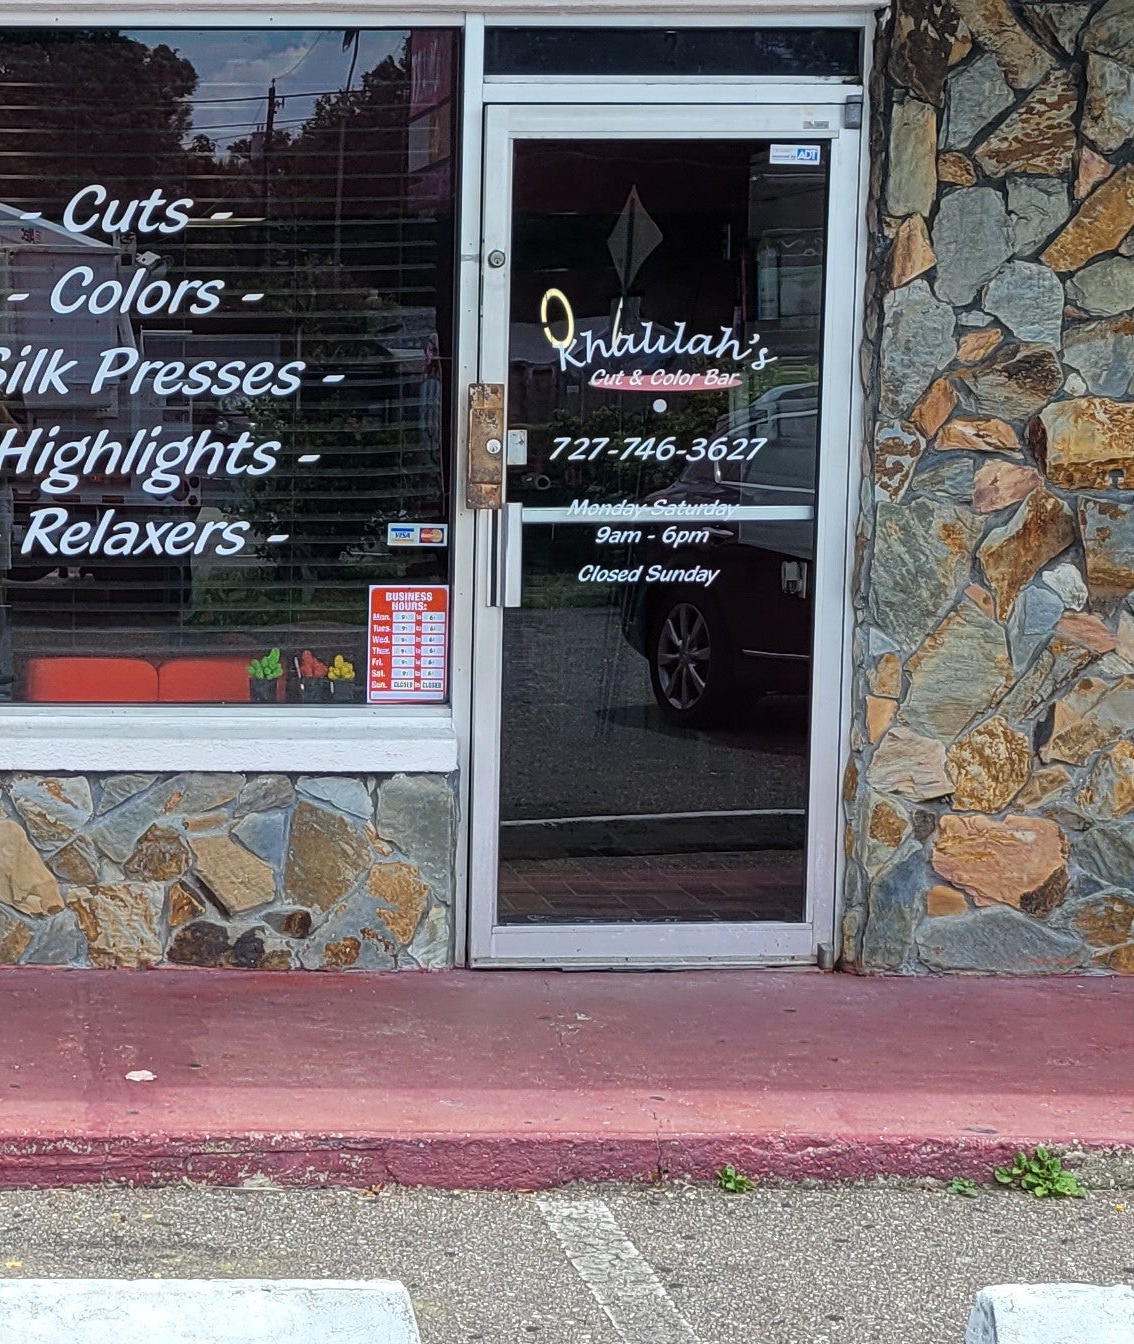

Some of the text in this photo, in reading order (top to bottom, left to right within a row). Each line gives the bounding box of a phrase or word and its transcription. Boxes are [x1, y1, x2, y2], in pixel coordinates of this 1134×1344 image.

[798, 149, 818, 160] ADT
[63, 184, 194, 233] Cuts
[50, 265, 226, 315] Colors
[552, 321, 778, 372] Khalilah's
[90, 346, 306, 395] Presses
[590, 368, 741, 387] Cut & Color Bar
[549, 437, 768, 462] 727-746-3627
[20, 507, 251, 556] Relaxers
[595, 526, 641, 544] 9am
[661, 526, 709, 548] 6pm
[578, 564, 720, 586] Closed Sunday
[386, 592, 433, 601] BUSINESS
[392, 601, 428, 611] HOURS:
